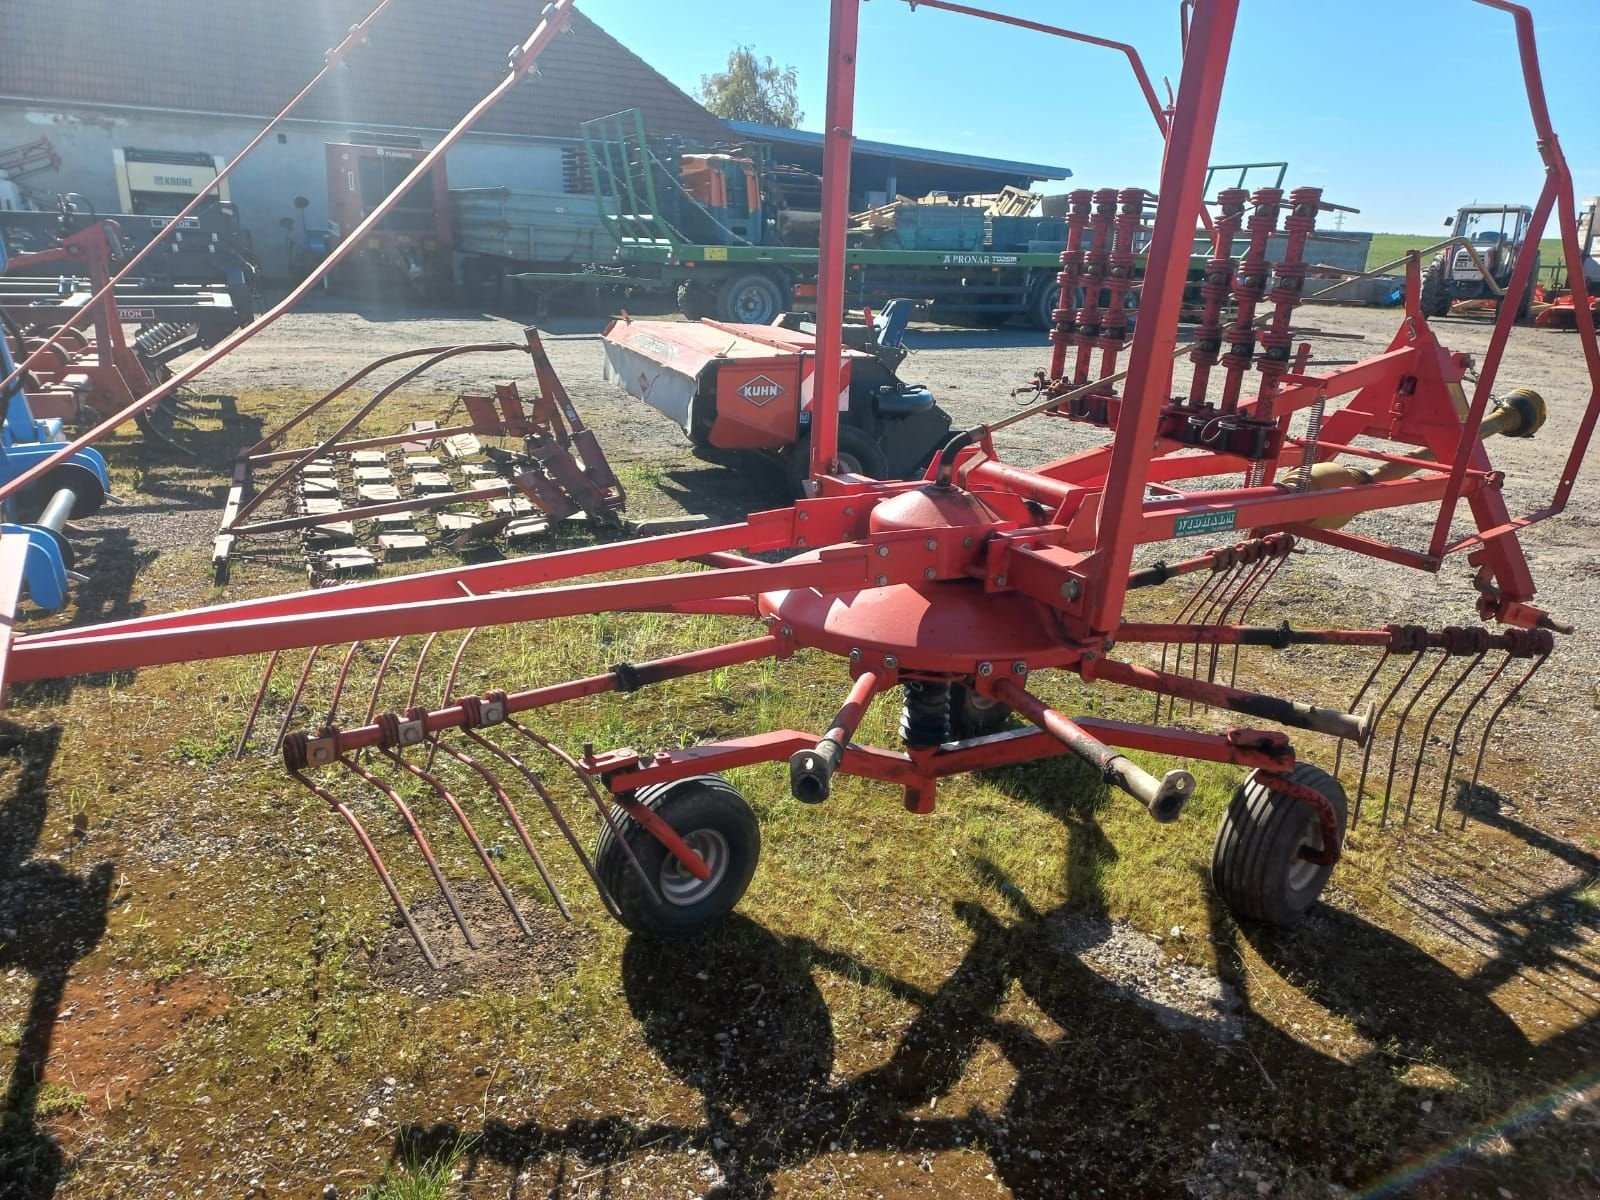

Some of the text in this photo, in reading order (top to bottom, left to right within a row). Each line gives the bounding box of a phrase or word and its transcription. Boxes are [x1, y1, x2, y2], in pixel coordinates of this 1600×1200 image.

[163, 177, 192, 187] KRONE
[953, 255, 990, 264] PRONAR
[744, 386, 777, 396] KUHN
